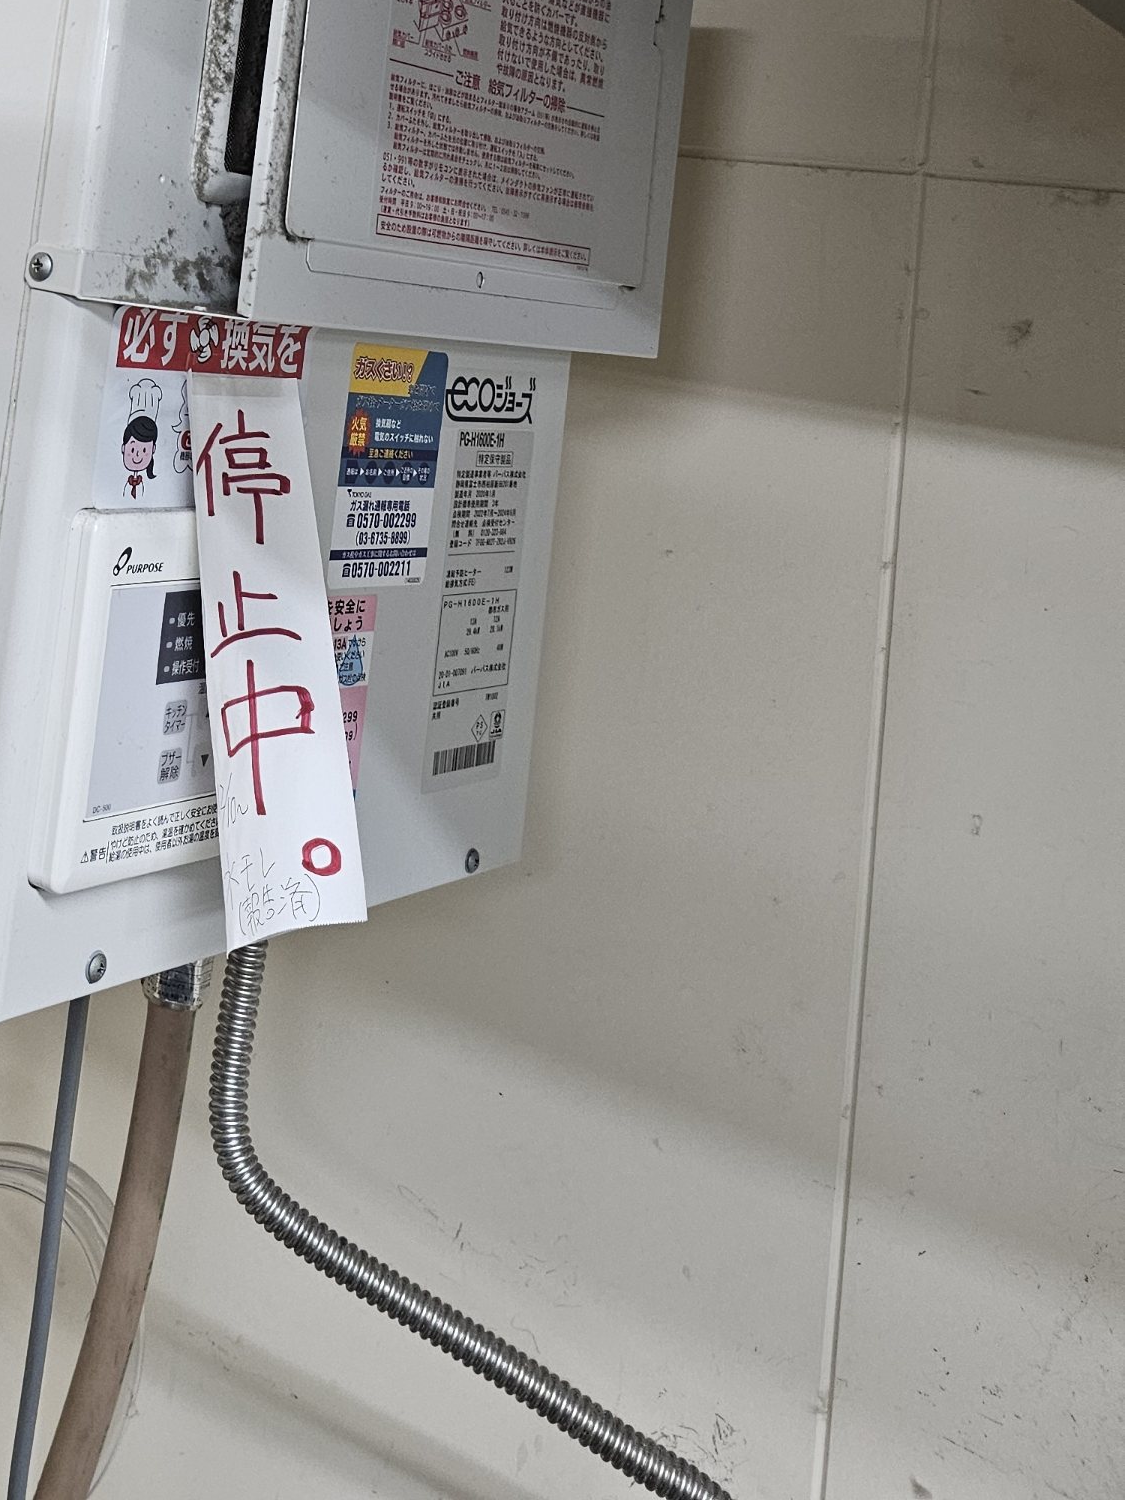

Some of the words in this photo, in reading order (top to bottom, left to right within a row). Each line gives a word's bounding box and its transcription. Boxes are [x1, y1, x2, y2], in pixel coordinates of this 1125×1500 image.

[455, 68, 480, 90] ご注意
[488, 77, 565, 113] 給気フィルターの掃除
[381, 172, 415, 187] してください。
[123, 309, 190, 367] 必ず
[220, 318, 302, 374] 換気を
[353, 355, 414, 383] ガスくさい!?
[446, 374, 537, 425] ecoジョーズ
[351, 416, 367, 431] 火気
[349, 432, 365, 446] 厳禁
[373, 431, 433, 443] 電気のスイッチに触れない
[459, 430, 504, 447] PG-H1600E-1H
[478, 453, 511, 464] 特定保守製品
[350, 499, 410, 511] ガス漏れ通報専用電話
[356, 512, 416, 528] 0570-002299
[355, 530, 411, 545] (03-6735-8899)
[125, 562, 164, 574] PURPOSE
[350, 560, 410, 577] 0570-002211
[177, 612, 195, 627] 優先
[330, 615, 363, 632] しょう
[173, 636, 194, 652] 燃焼
[196, 409, 342, 877] 停止中。
[171, 659, 200, 676] 操作受付
[165, 704, 188, 719] キッチン
[163, 720, 186, 735] タイマー
[161, 751, 182, 767] ブザー
[159, 765, 180, 782] 解除
[92, 804, 111, 815] DC-500
[90, 847, 107, 862] 警告
